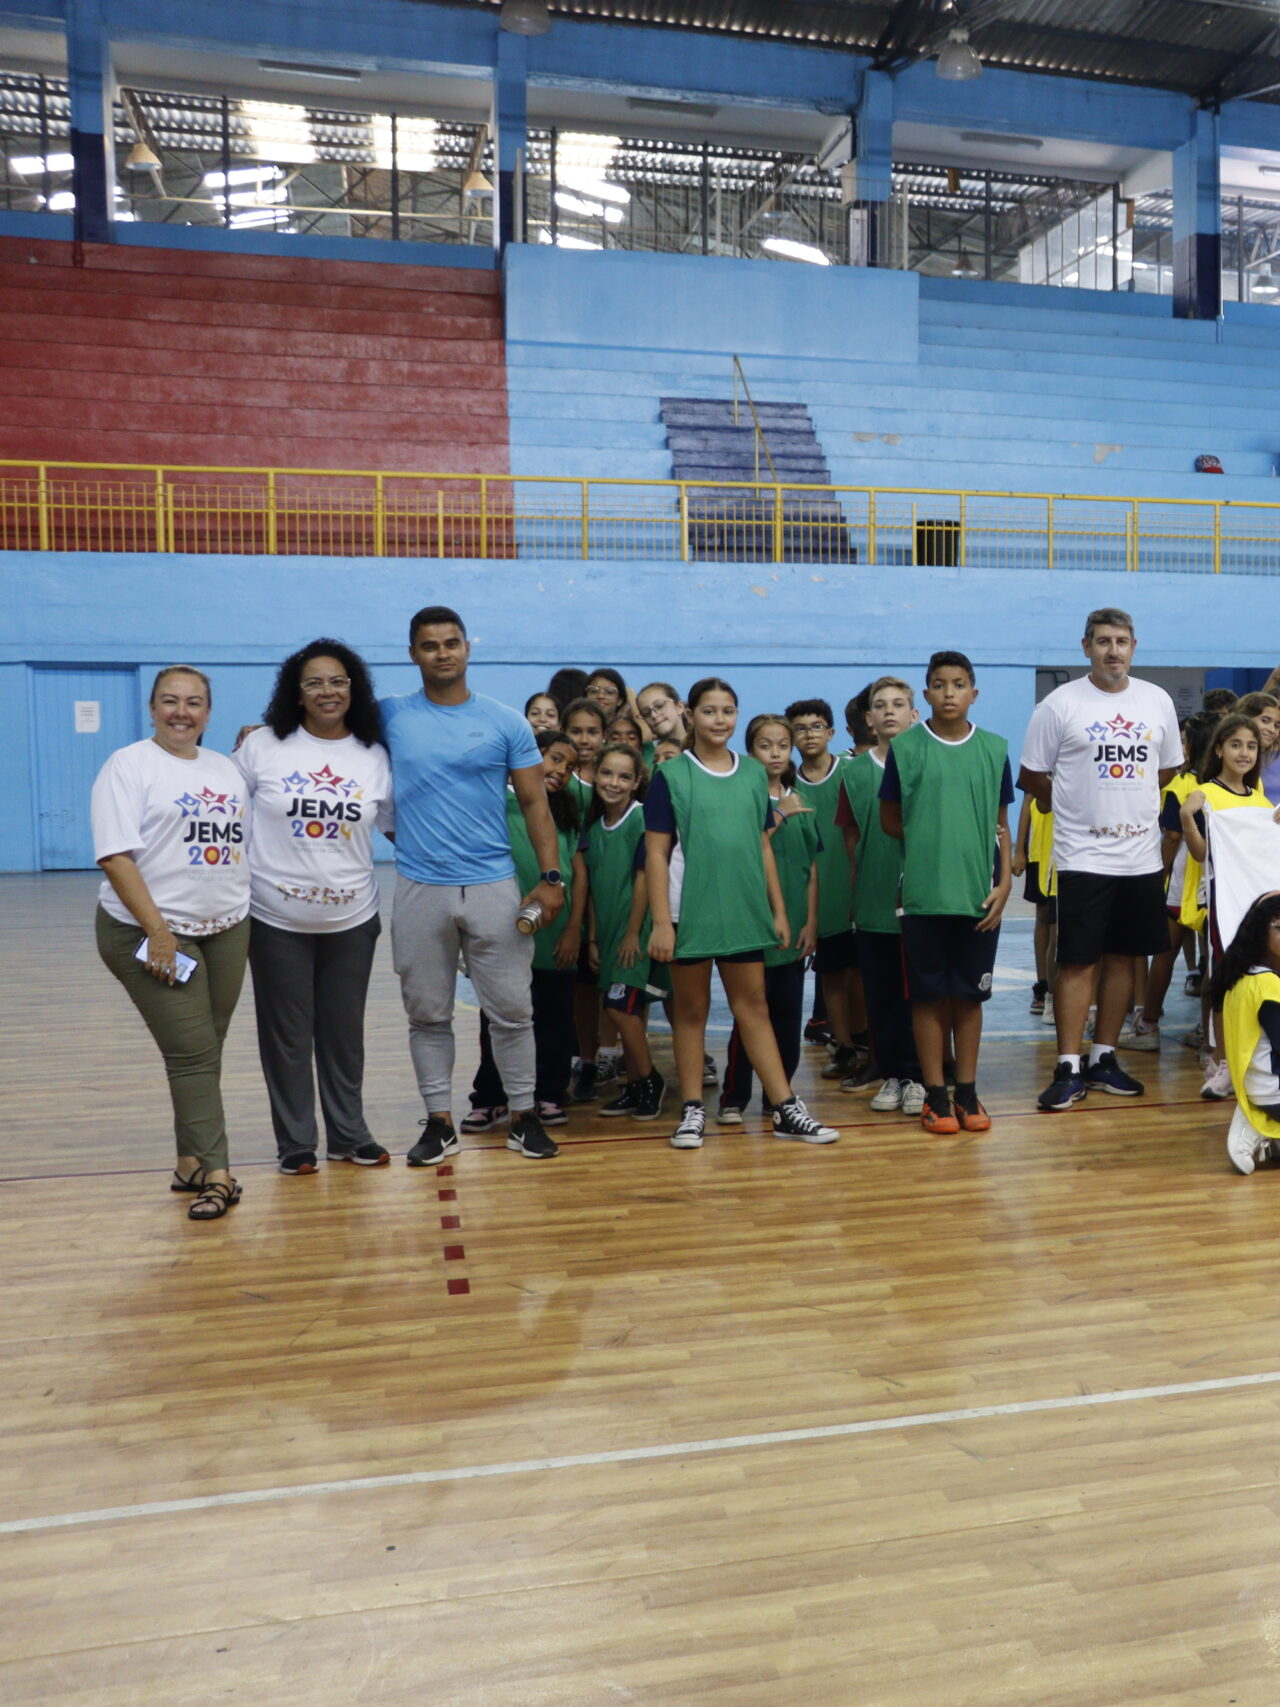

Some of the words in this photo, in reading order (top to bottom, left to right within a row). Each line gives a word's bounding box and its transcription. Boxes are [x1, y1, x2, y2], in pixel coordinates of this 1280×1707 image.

[1094, 745, 1148, 762] JEMS
[1098, 763, 1145, 779] 2024
[286, 797, 362, 822] JEMS
[184, 821, 243, 844] JEMS
[291, 819, 352, 841] 2024
[188, 845, 240, 865] 2024
